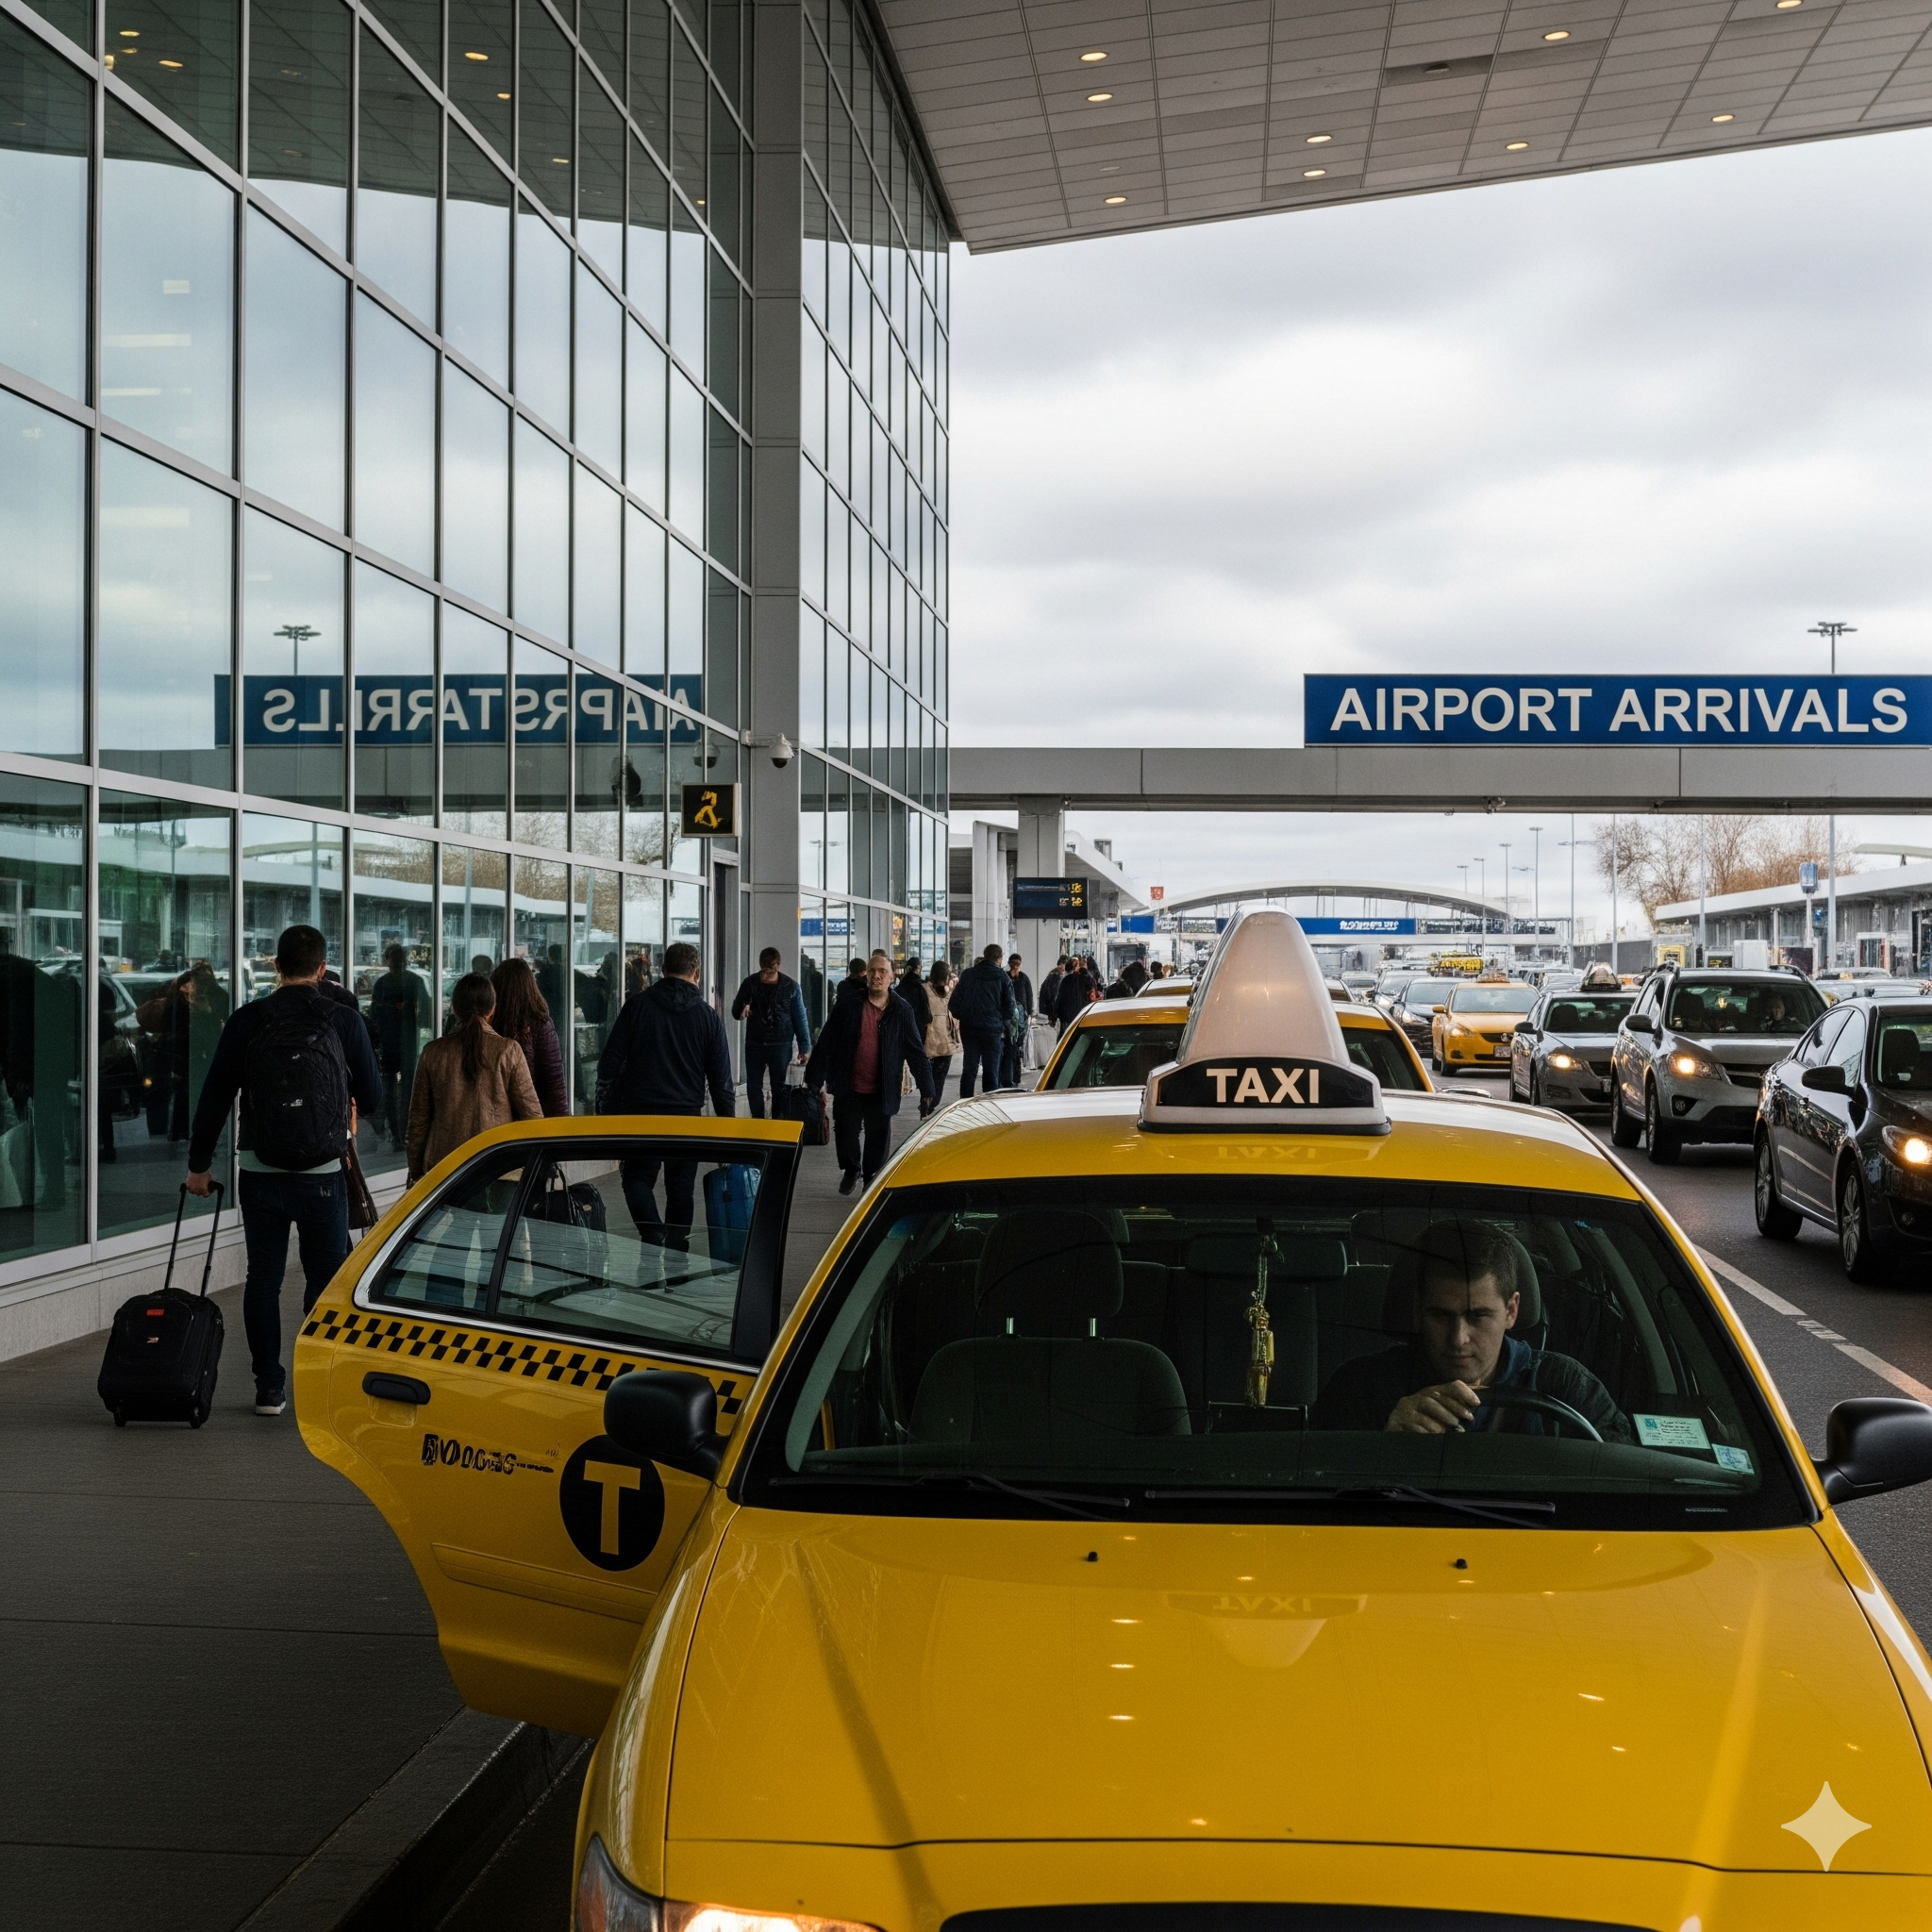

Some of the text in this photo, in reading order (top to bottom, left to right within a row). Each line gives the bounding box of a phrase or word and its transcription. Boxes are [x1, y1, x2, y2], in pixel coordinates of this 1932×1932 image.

[1329, 687, 1908, 733] AIRPORT ARRIVALS
[1206, 1067, 1320, 1104] TAXI
[583, 1459, 641, 1556] T
